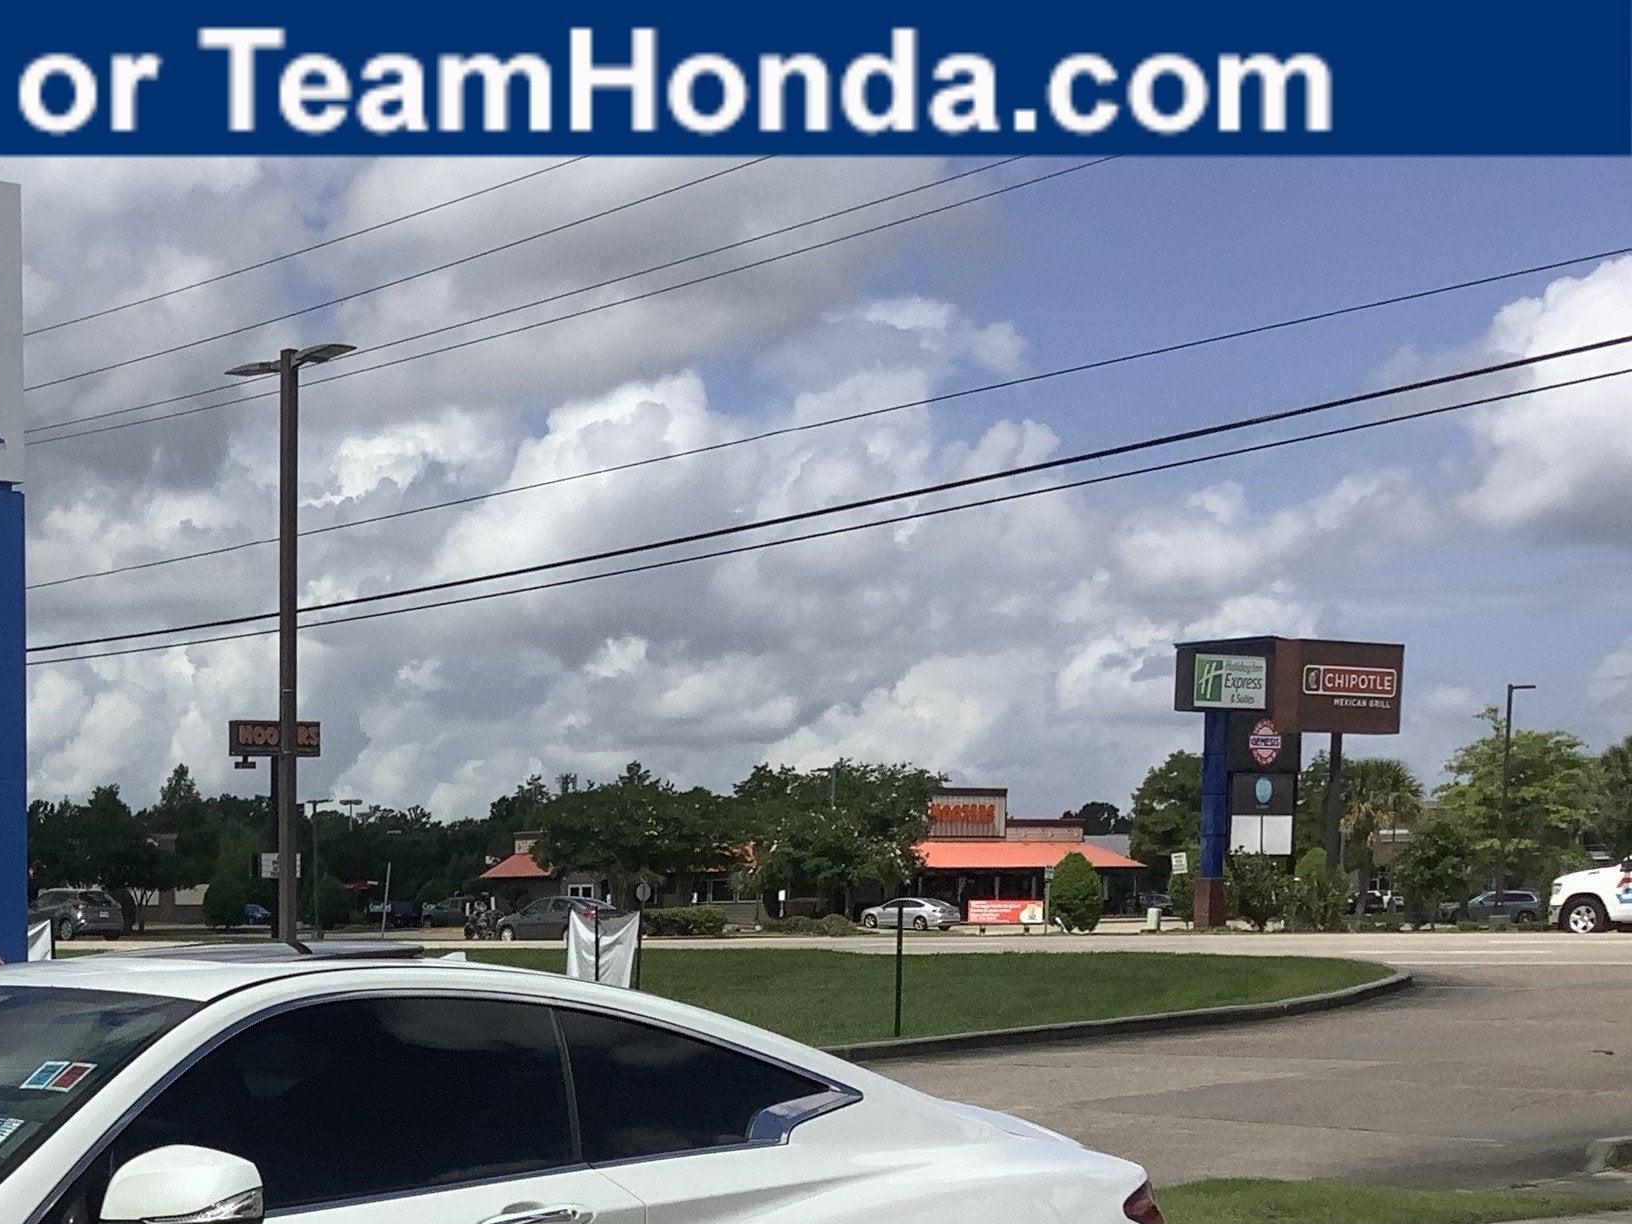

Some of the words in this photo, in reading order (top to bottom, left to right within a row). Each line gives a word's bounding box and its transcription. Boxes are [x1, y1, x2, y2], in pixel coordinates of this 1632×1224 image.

[1224, 673, 1263, 692] Express
[1324, 673, 1393, 691] CHIPOTLE
[1333, 698, 1367, 707] MEXICAN
[1369, 700, 1391, 709] GRILL
[238, 725, 319, 746] HOORS
